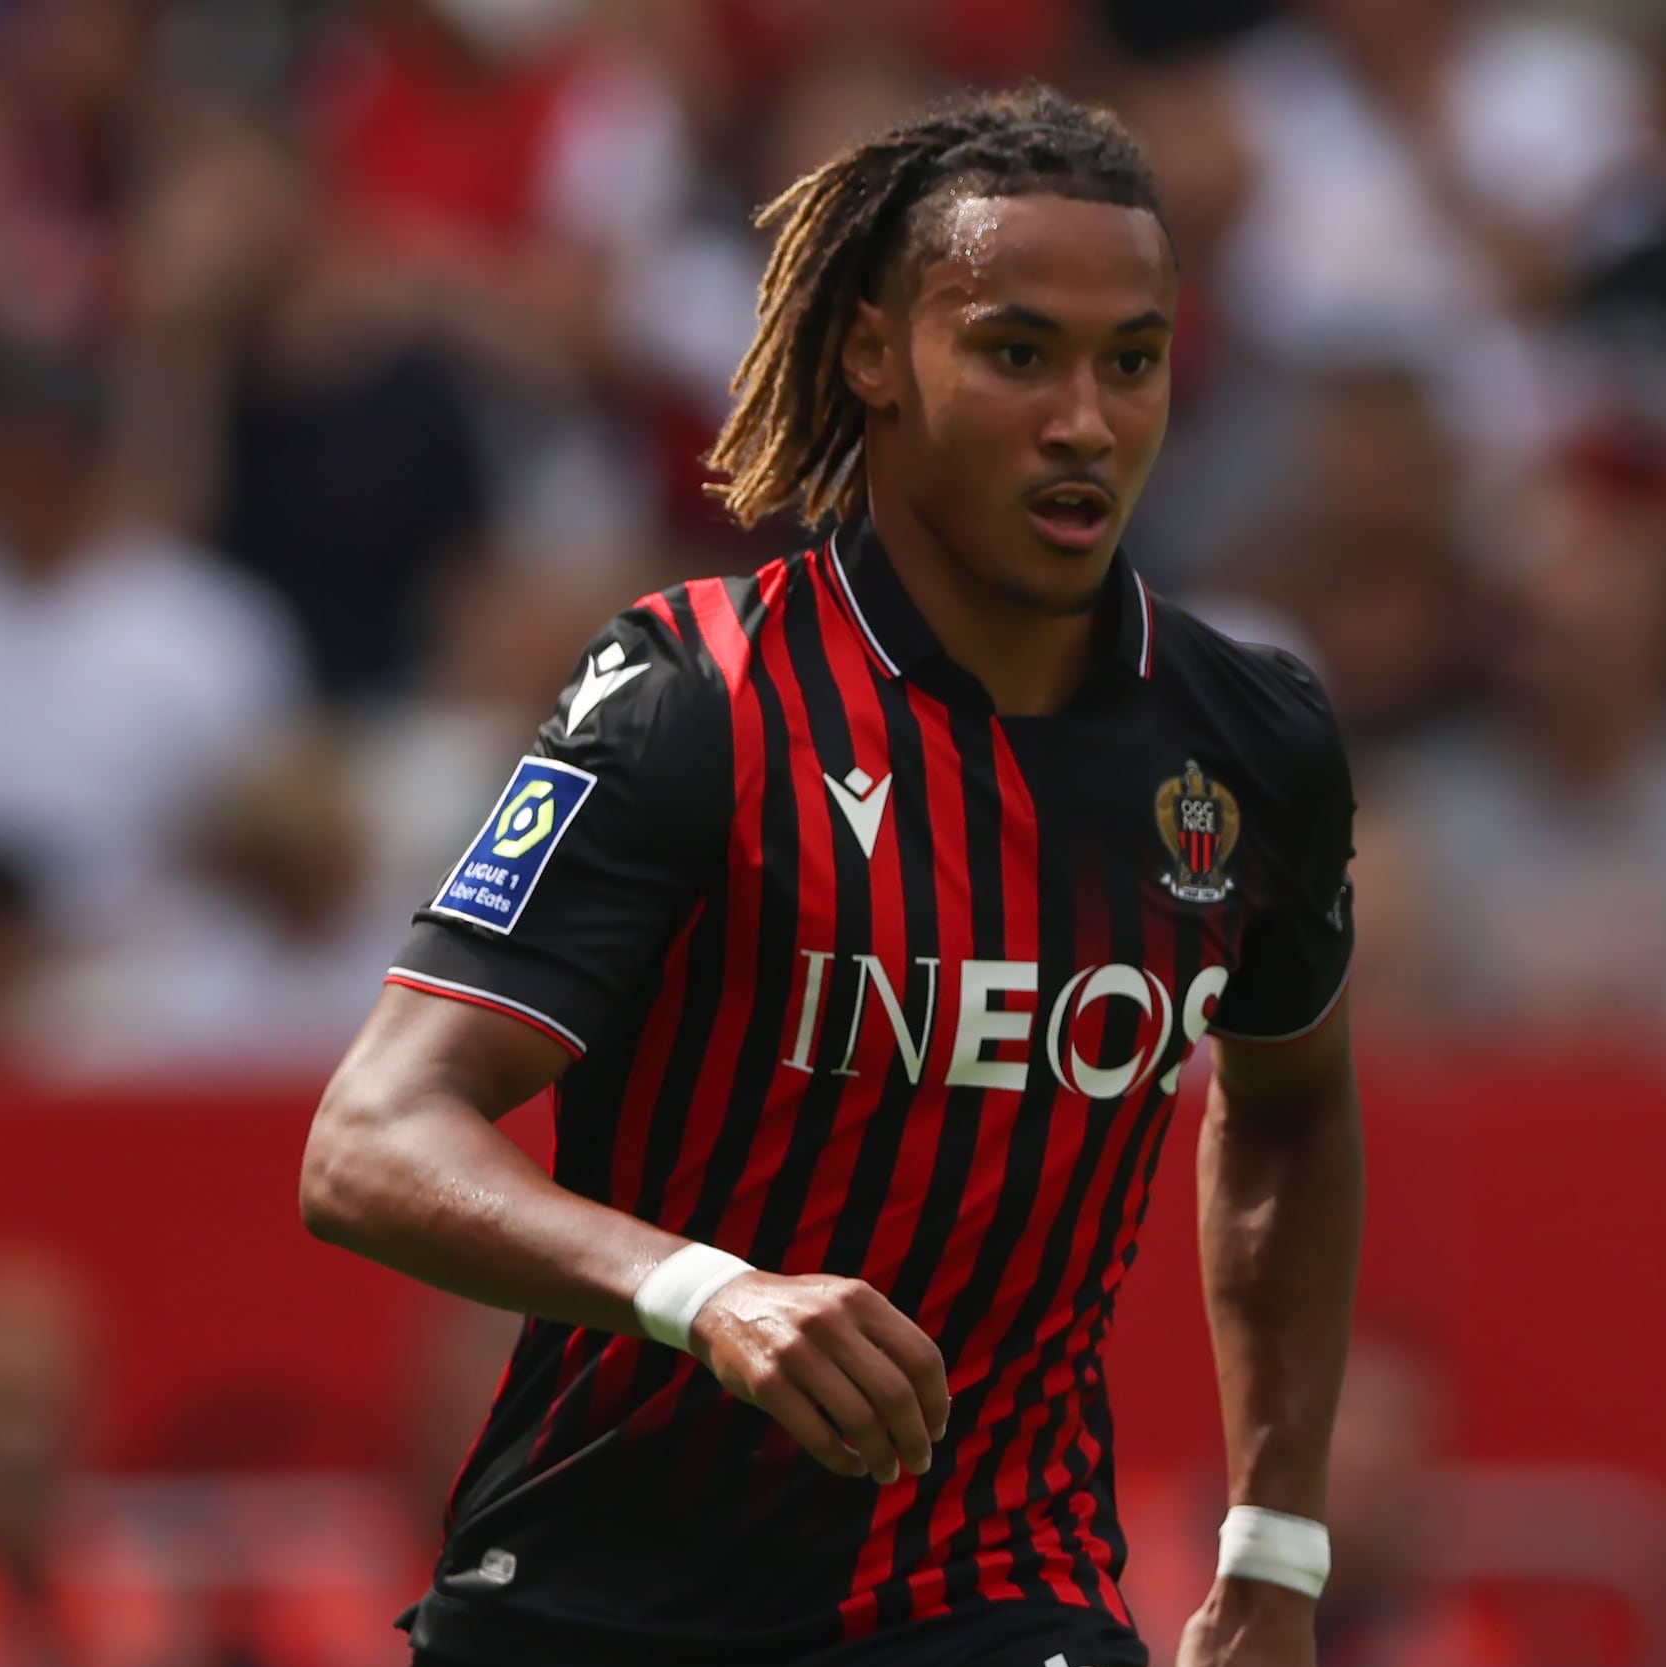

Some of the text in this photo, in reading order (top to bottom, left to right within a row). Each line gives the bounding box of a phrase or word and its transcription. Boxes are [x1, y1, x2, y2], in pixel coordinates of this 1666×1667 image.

[1181, 800, 1214, 816] OGC
[1183, 815, 1215, 834] NICE
[464, 861, 521, 891] LIGUE 1
[448, 881, 512, 914] Uber Eats
